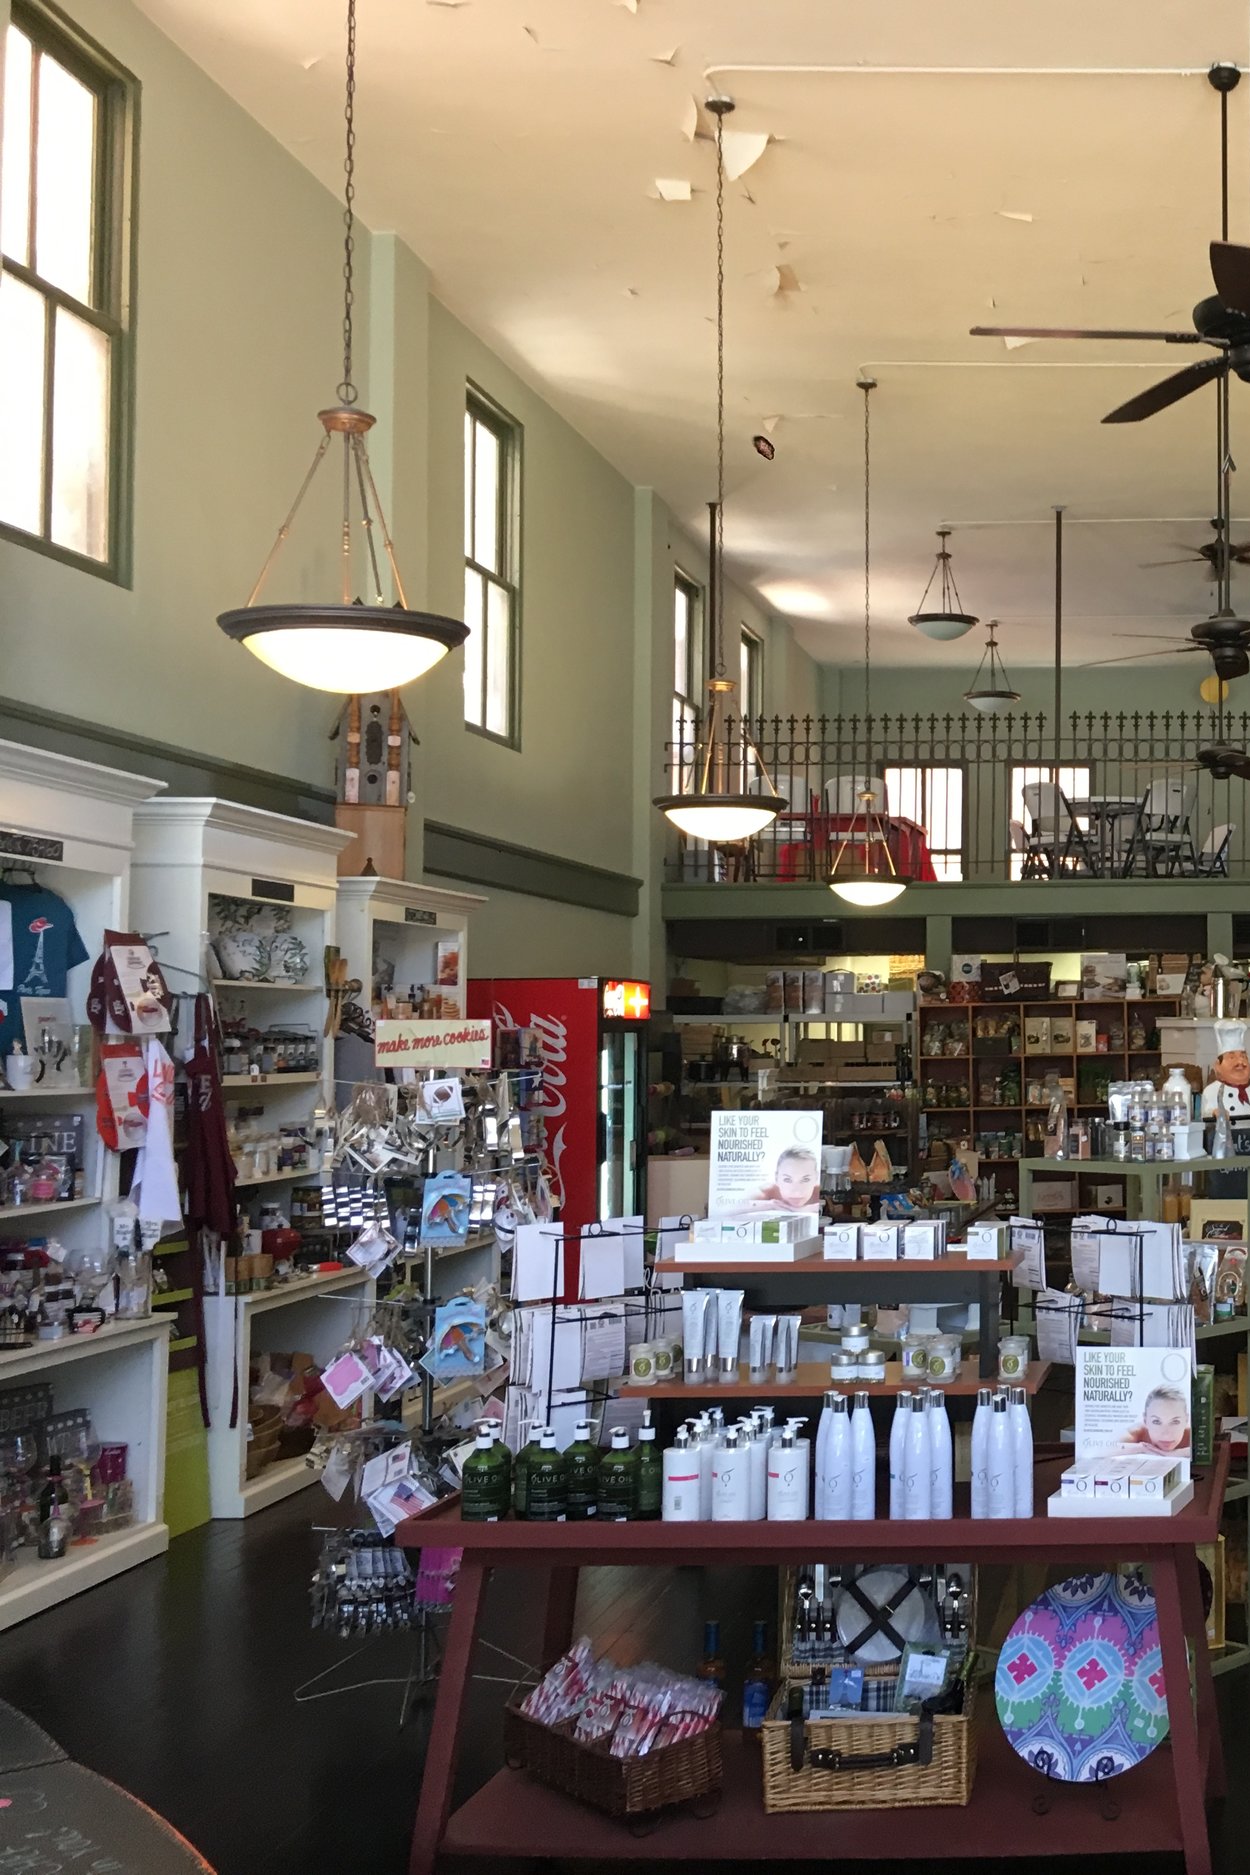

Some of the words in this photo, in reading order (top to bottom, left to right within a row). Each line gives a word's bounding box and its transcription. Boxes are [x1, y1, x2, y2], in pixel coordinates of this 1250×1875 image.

[377, 1033, 410, 1054] make
[411, 1034, 442, 1050] more
[443, 1025, 490, 1046] cookies
[718, 1115, 736, 1126] LIKE
[738, 1115, 760, 1126] YOUR
[718, 1127, 737, 1138] SKIN
[739, 1127, 749, 1138] TO
[750, 1128, 769, 1138] FEEL
[717, 1139, 764, 1150] NOURISHED
[717, 1151, 766, 1162] NATURALLY?
[1083, 1352, 1102, 1363] LIKE
[1103, 1352, 1126, 1363] YOUR
[1083, 1364, 1103, 1376] SKIN
[1104, 1364, 1115, 1376] TO
[1116, 1365, 1136, 1376] FEEL
[1083, 1377, 1130, 1389] NOURISHED
[1083, 1390, 1133, 1402] NATURALLY?
